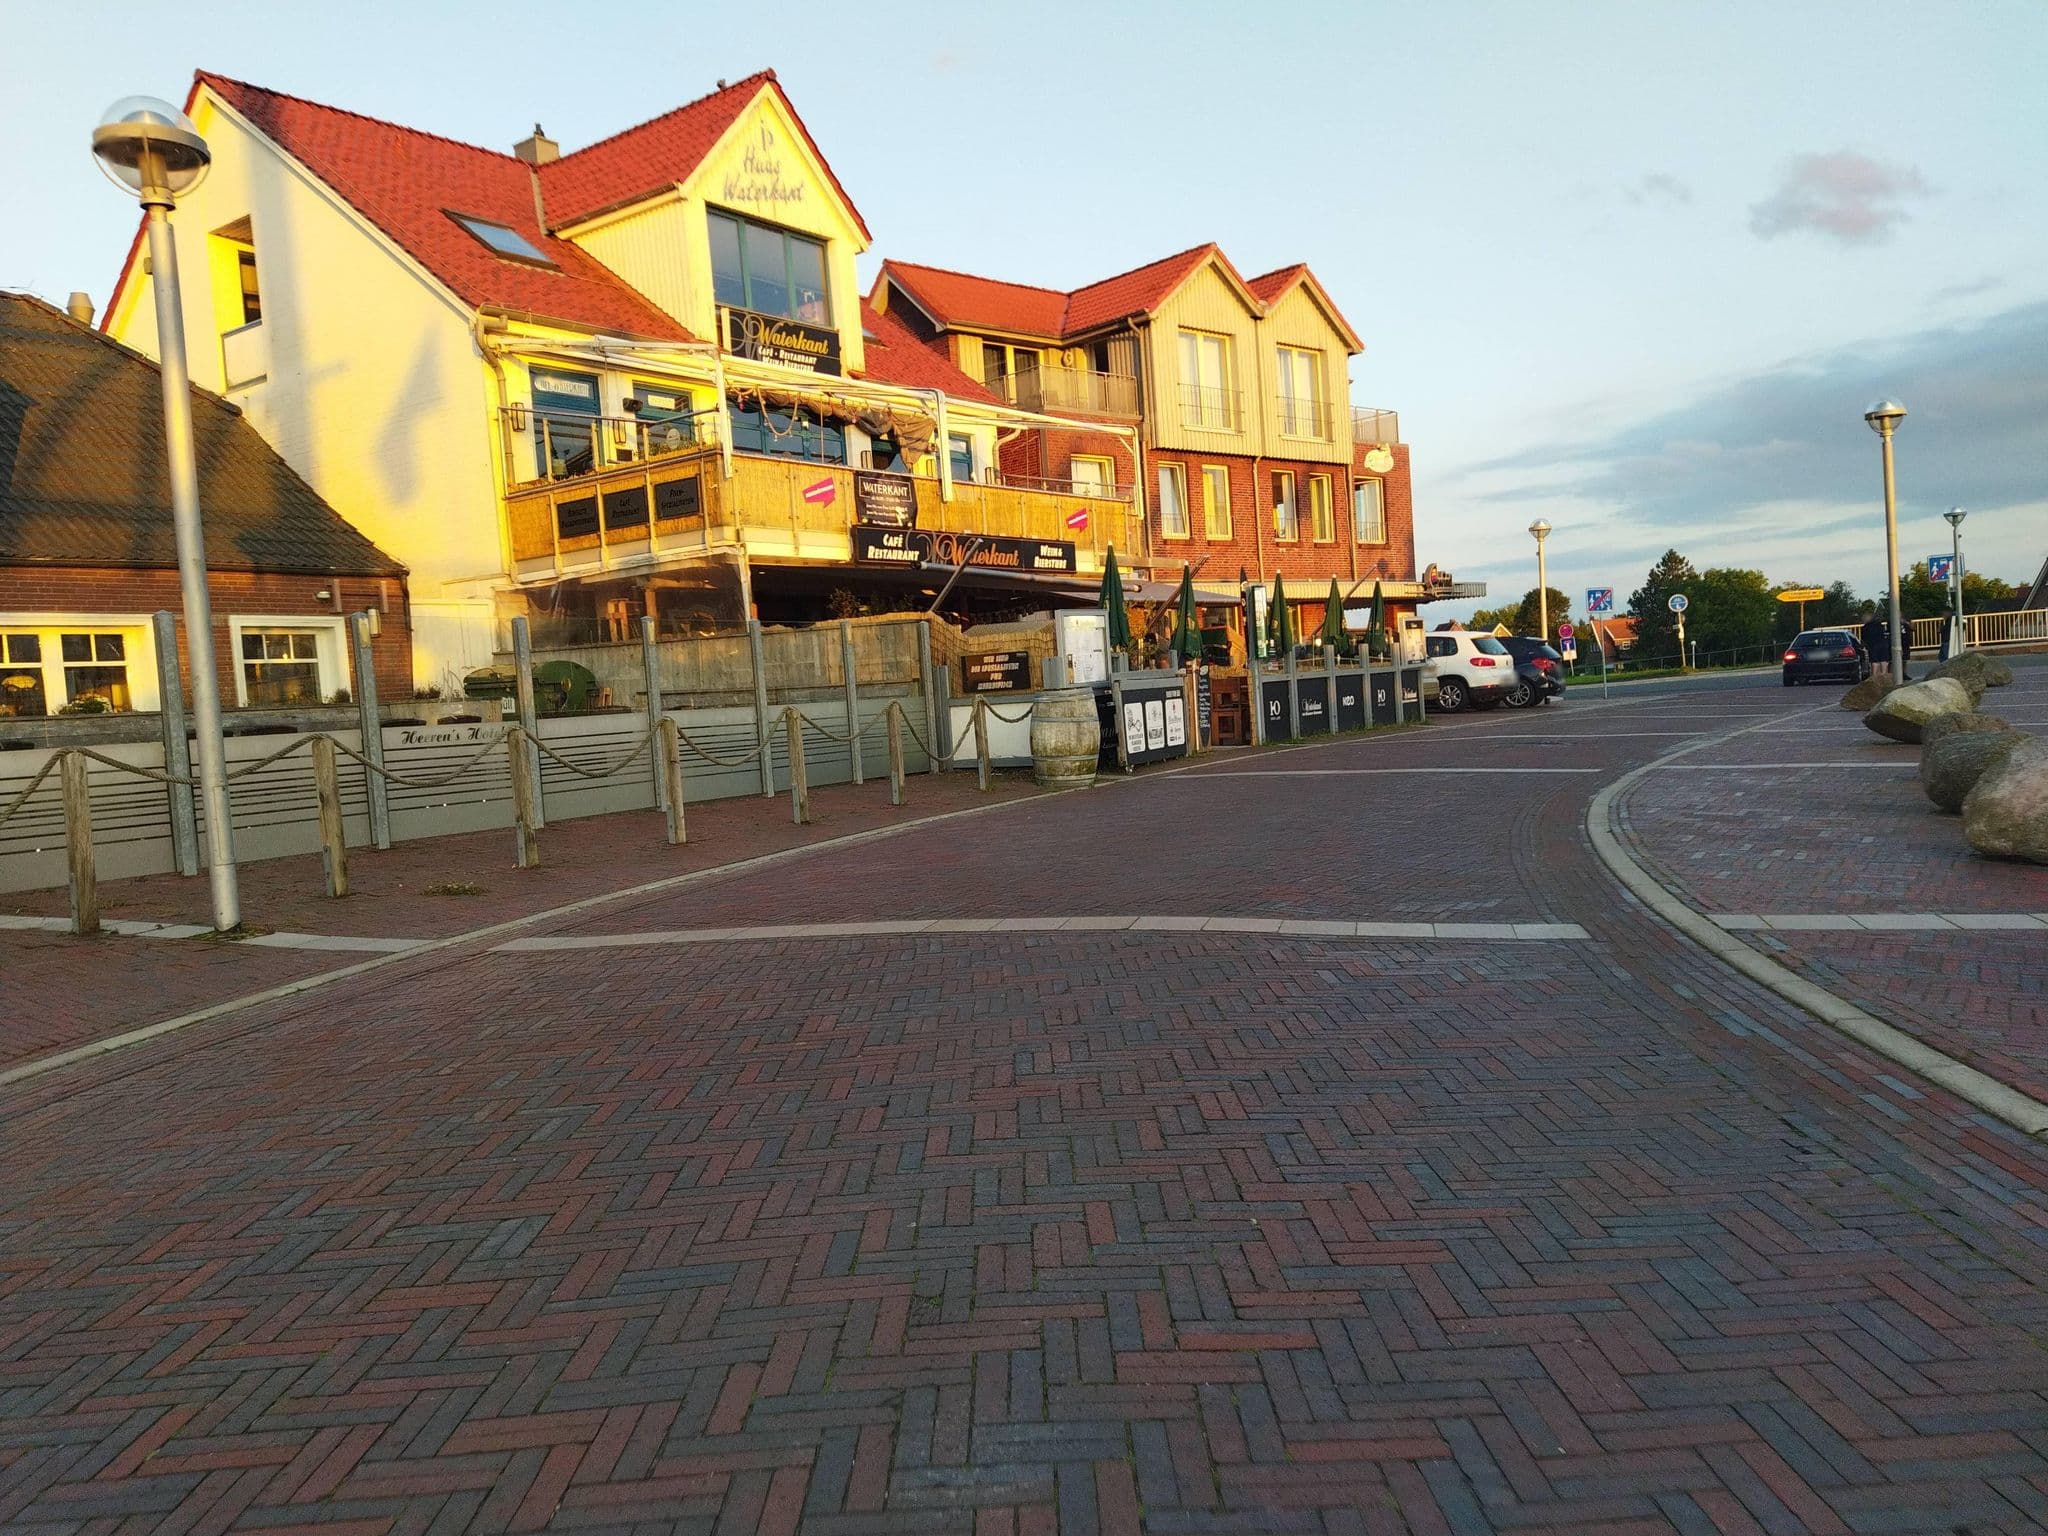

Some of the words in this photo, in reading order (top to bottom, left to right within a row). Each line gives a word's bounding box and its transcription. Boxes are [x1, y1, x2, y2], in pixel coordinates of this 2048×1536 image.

[743, 314, 829, 355] Waterkant
[863, 482, 908, 497] WATERKANT
[883, 533, 903, 548] CAFÉ
[867, 545, 920, 561] RESTAURANT
[936, 533, 1019, 567] Wterkant
[401, 729, 460, 745] Heeren's
